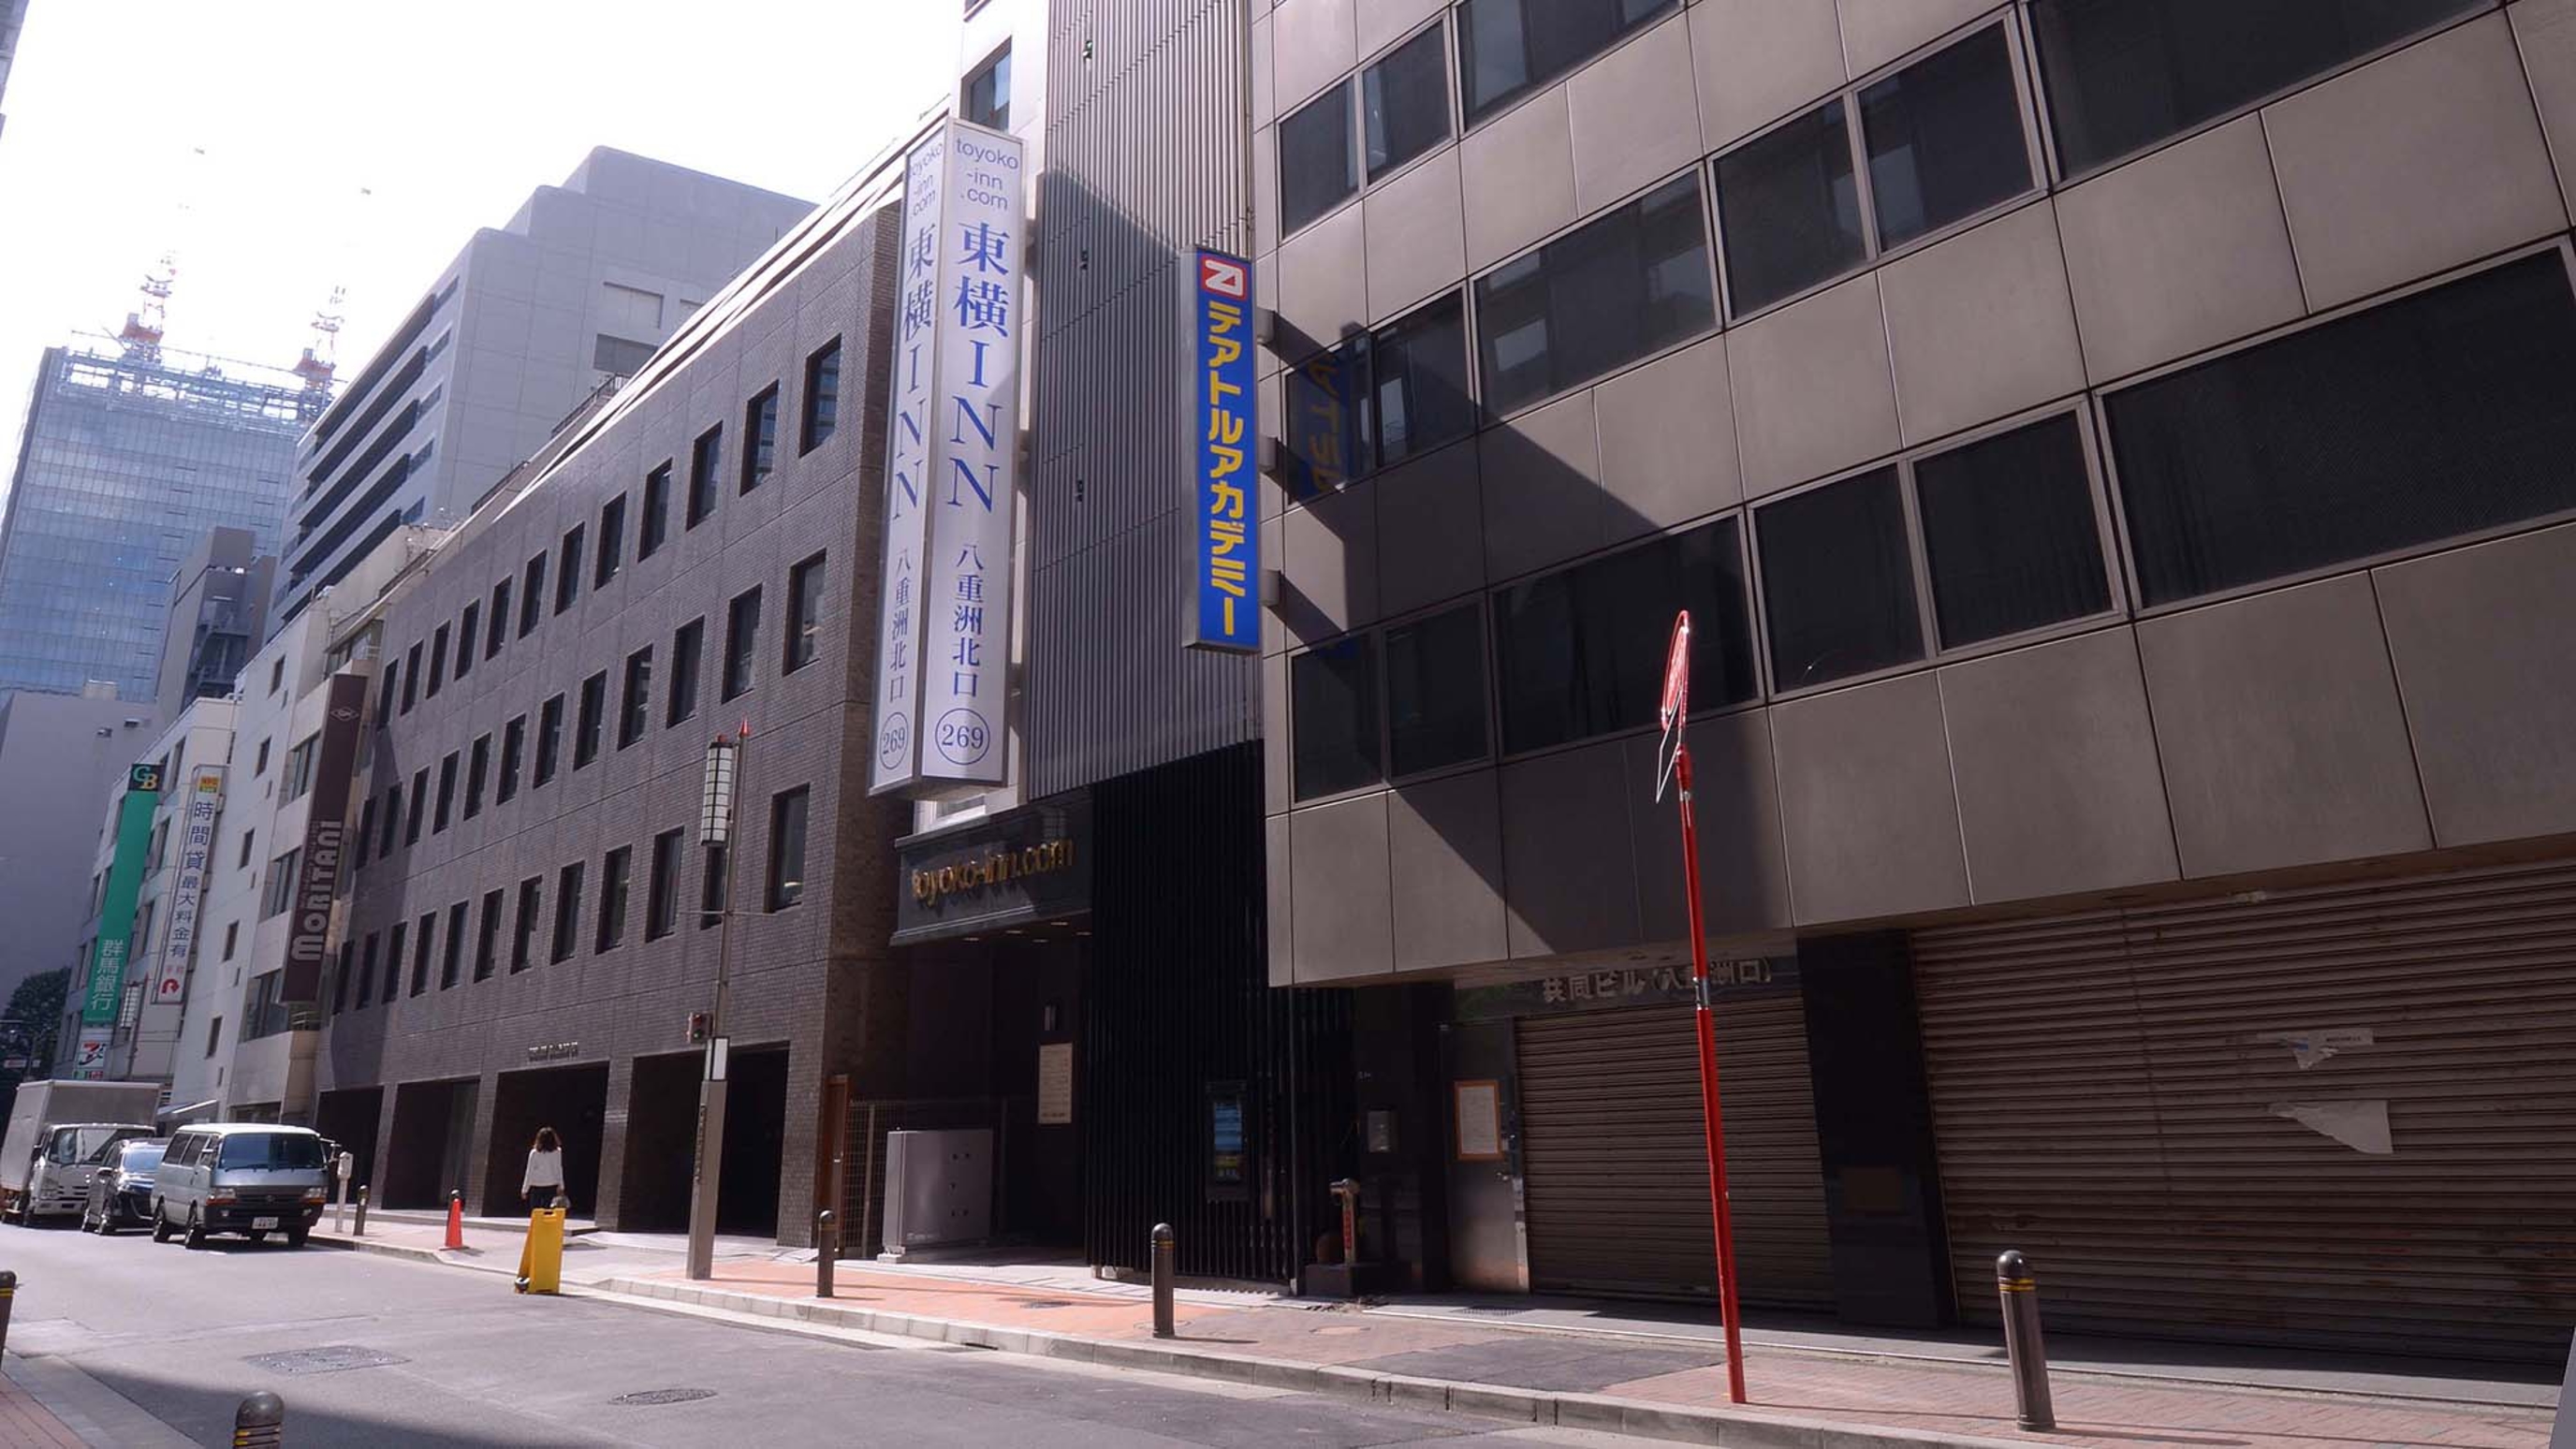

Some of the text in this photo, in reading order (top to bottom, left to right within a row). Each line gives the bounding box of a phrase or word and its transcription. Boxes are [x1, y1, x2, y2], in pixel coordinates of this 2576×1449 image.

[911, 141, 943, 178] toyoko
[956, 138, 1019, 170] toyoko
[960, 188, 1008, 211] .com
[966, 170, 1003, 191] -inn
[892, 223, 937, 520] 東横INN
[948, 221, 1010, 513] 東横INN
[1208, 300, 1246, 637] テアトルアカデミー
[889, 548, 912, 703] 八重洲北口
[952, 543, 984, 698] 八重洲北口
[883, 726, 906, 754] 269
[941, 724, 984, 749] 269
[132, 765, 158, 790] GB
[292, 820, 342, 961] MORITANI
[91, 939, 124, 1011] 群馬銀行
[1543, 958, 1773, 1003] 共同ビル(八洲口)
